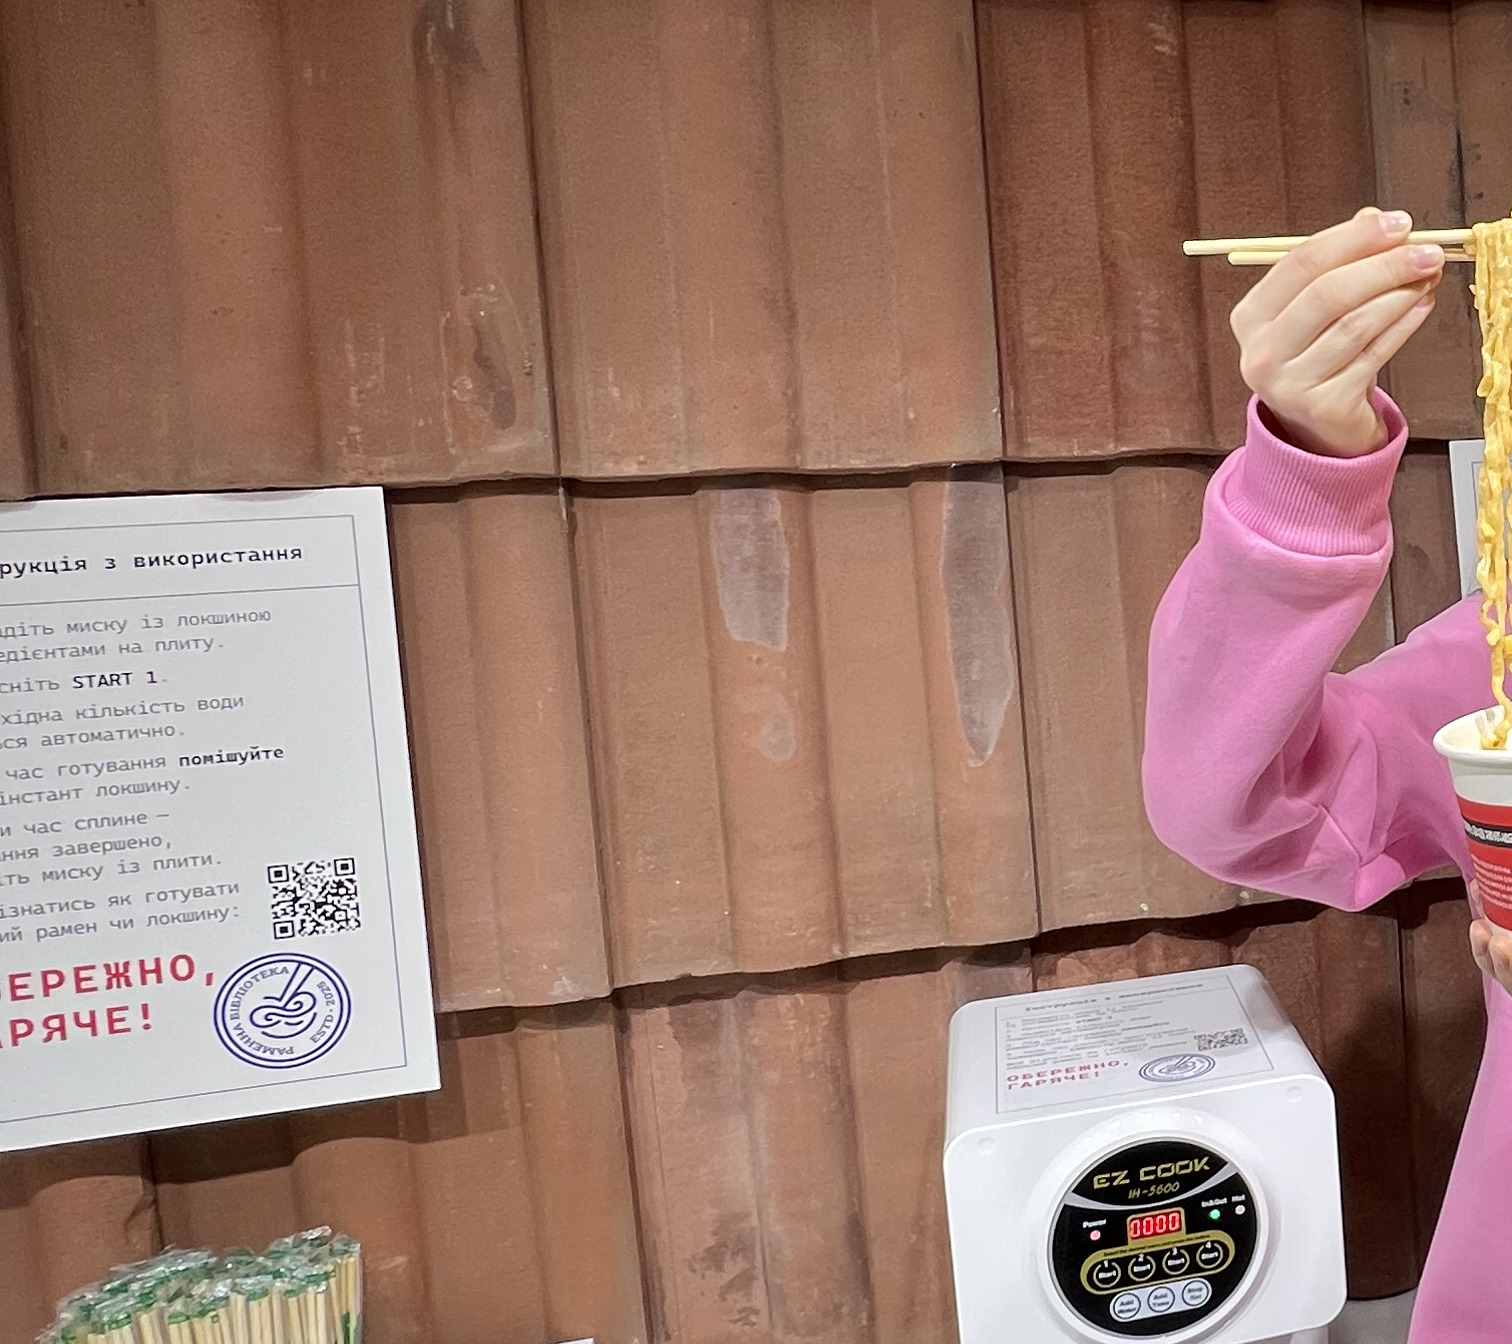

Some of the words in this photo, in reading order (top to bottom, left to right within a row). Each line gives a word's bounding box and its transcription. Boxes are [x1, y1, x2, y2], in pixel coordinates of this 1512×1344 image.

[0, 556, 87, 579] рукція
[105, 558, 116, 570] з
[134, 548, 302, 569] використання
[0, 622, 54, 639] діть
[66, 620, 127, 634] миску
[141, 614, 164, 630] із
[177, 610, 271, 627] локшиною
[118, 642, 143, 655] на
[155, 638, 224, 653] плиту.
[0, 677, 60, 693] сніть
[73, 672, 133, 689] START
[0, 709, 64, 725] хідна
[76, 700, 185, 719] кількість
[197, 697, 244, 711] води
[0, 737, 28, 750] ся
[41, 726, 184, 747] автоматично.
[5, 767, 44, 780] час
[57, 757, 167, 777] готування
[179, 746, 284, 767] помішуйте
[0, 787, 83, 806] інстант
[96, 780, 190, 797] локшину.
[23, 821, 62, 835] час
[74, 813, 148, 831] сплине
[0, 847, 39, 862] ння
[52, 836, 171, 857] завершено,
[0, 873, 30, 887] ть
[42, 866, 104, 882] миску
[117, 859, 141, 875] із
[153, 854, 222, 870] плити.
[108, 894, 132, 908] як
[145, 883, 240, 903] готувати
[0, 926, 23, 943] ий
[36, 922, 97, 942] рамен
[109, 918, 135, 930] чи
[147, 906, 240, 927] локшину:
[0, 954, 214, 1002] ЕРЕЖНО,
[230, 967, 290, 1020] БІБЛІОТЕКА
[0, 1003, 152, 1048] РЯЧЕ!
[232, 1022, 295, 1055] РАМЕННА
[310, 1014, 334, 1043] ESTD
[1093, 1170, 1130, 1189] EZ
[1139, 1156, 1210, 1181] COOK
[1130, 1212, 1181, 1238] 0000
